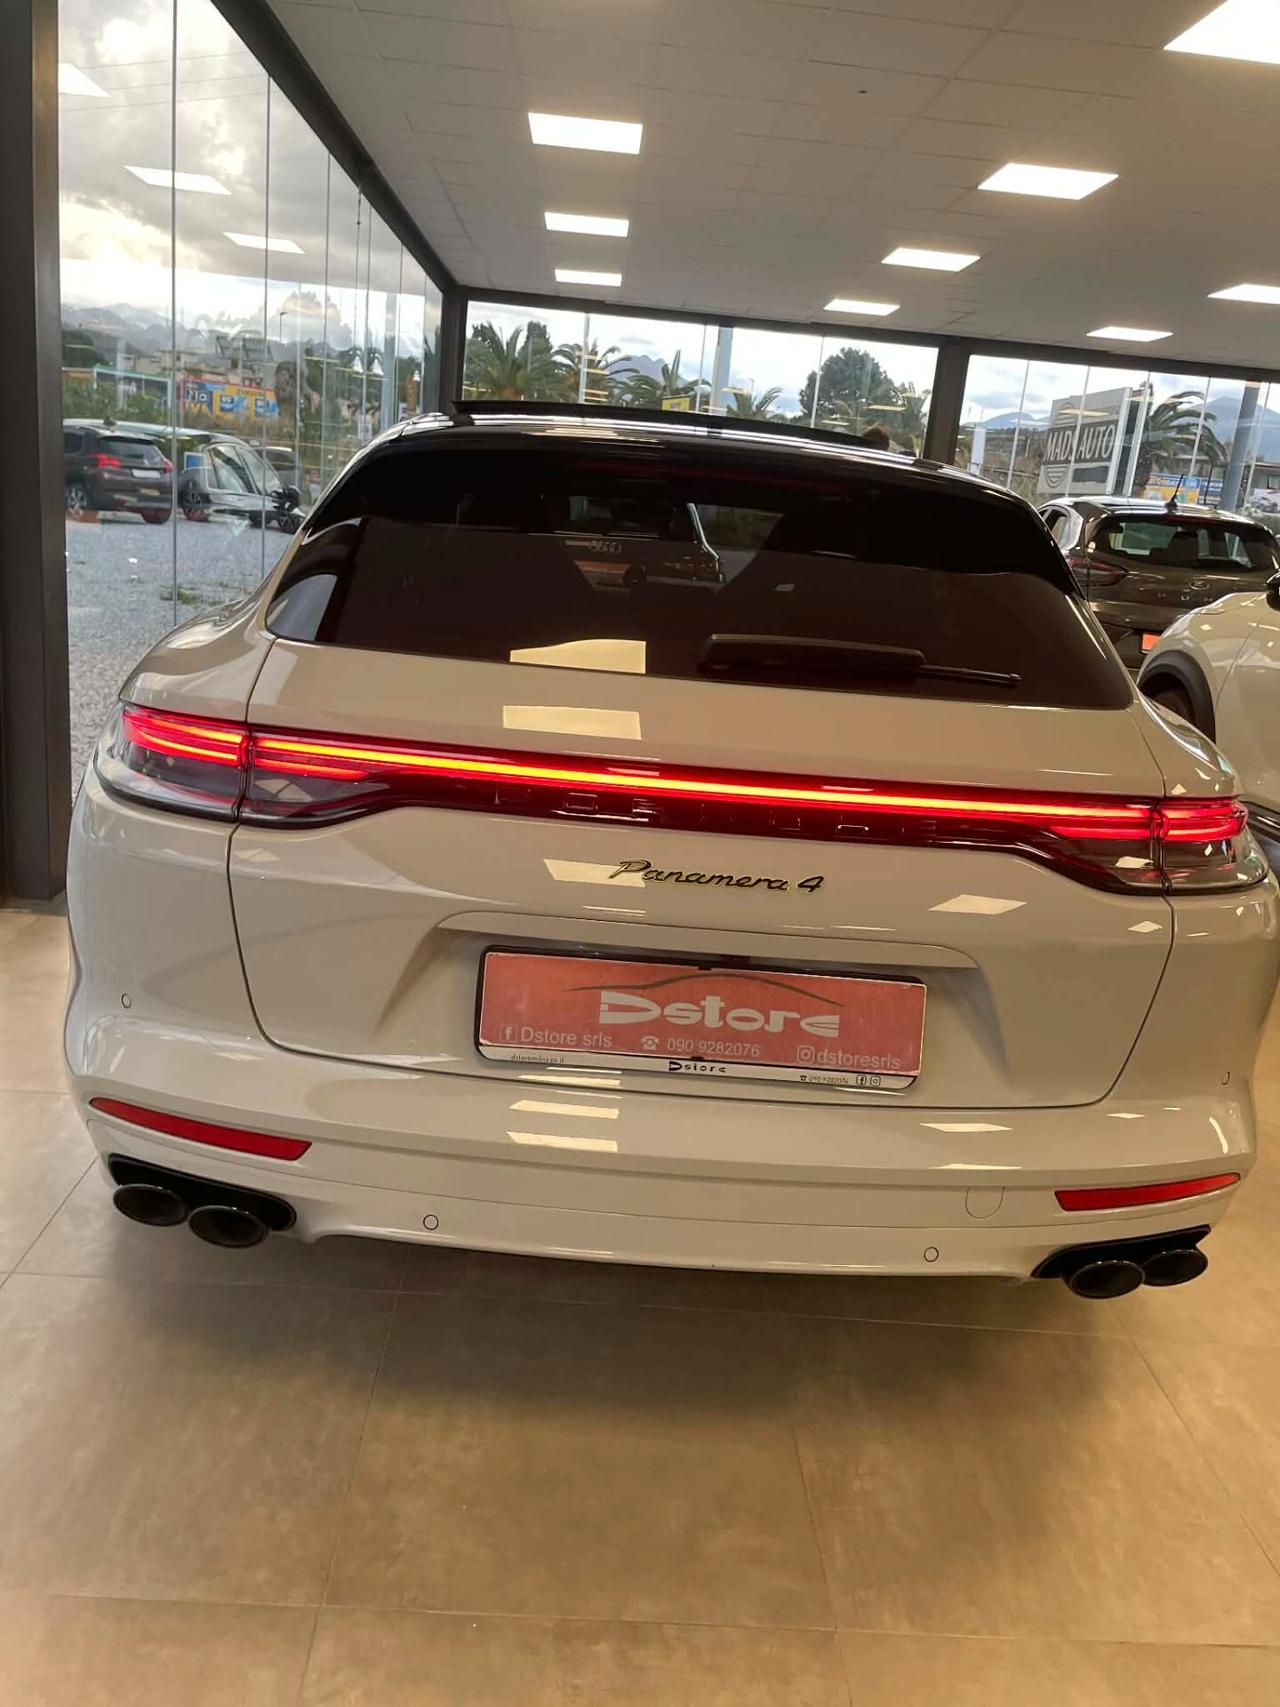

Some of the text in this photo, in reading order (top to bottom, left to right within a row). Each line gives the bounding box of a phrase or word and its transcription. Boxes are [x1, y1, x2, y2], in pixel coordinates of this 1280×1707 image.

[1076, 424, 1116, 460] AUTO
[608, 859, 825, 893] Panamera 4
[600, 990, 840, 1038] Dstore
[521, 1026, 613, 1048] Dstore srls
[667, 1038, 760, 1058] 090 9282076
[668, 1060, 727, 1073] Dstore
[817, 1047, 901, 1070] dstoresrls
